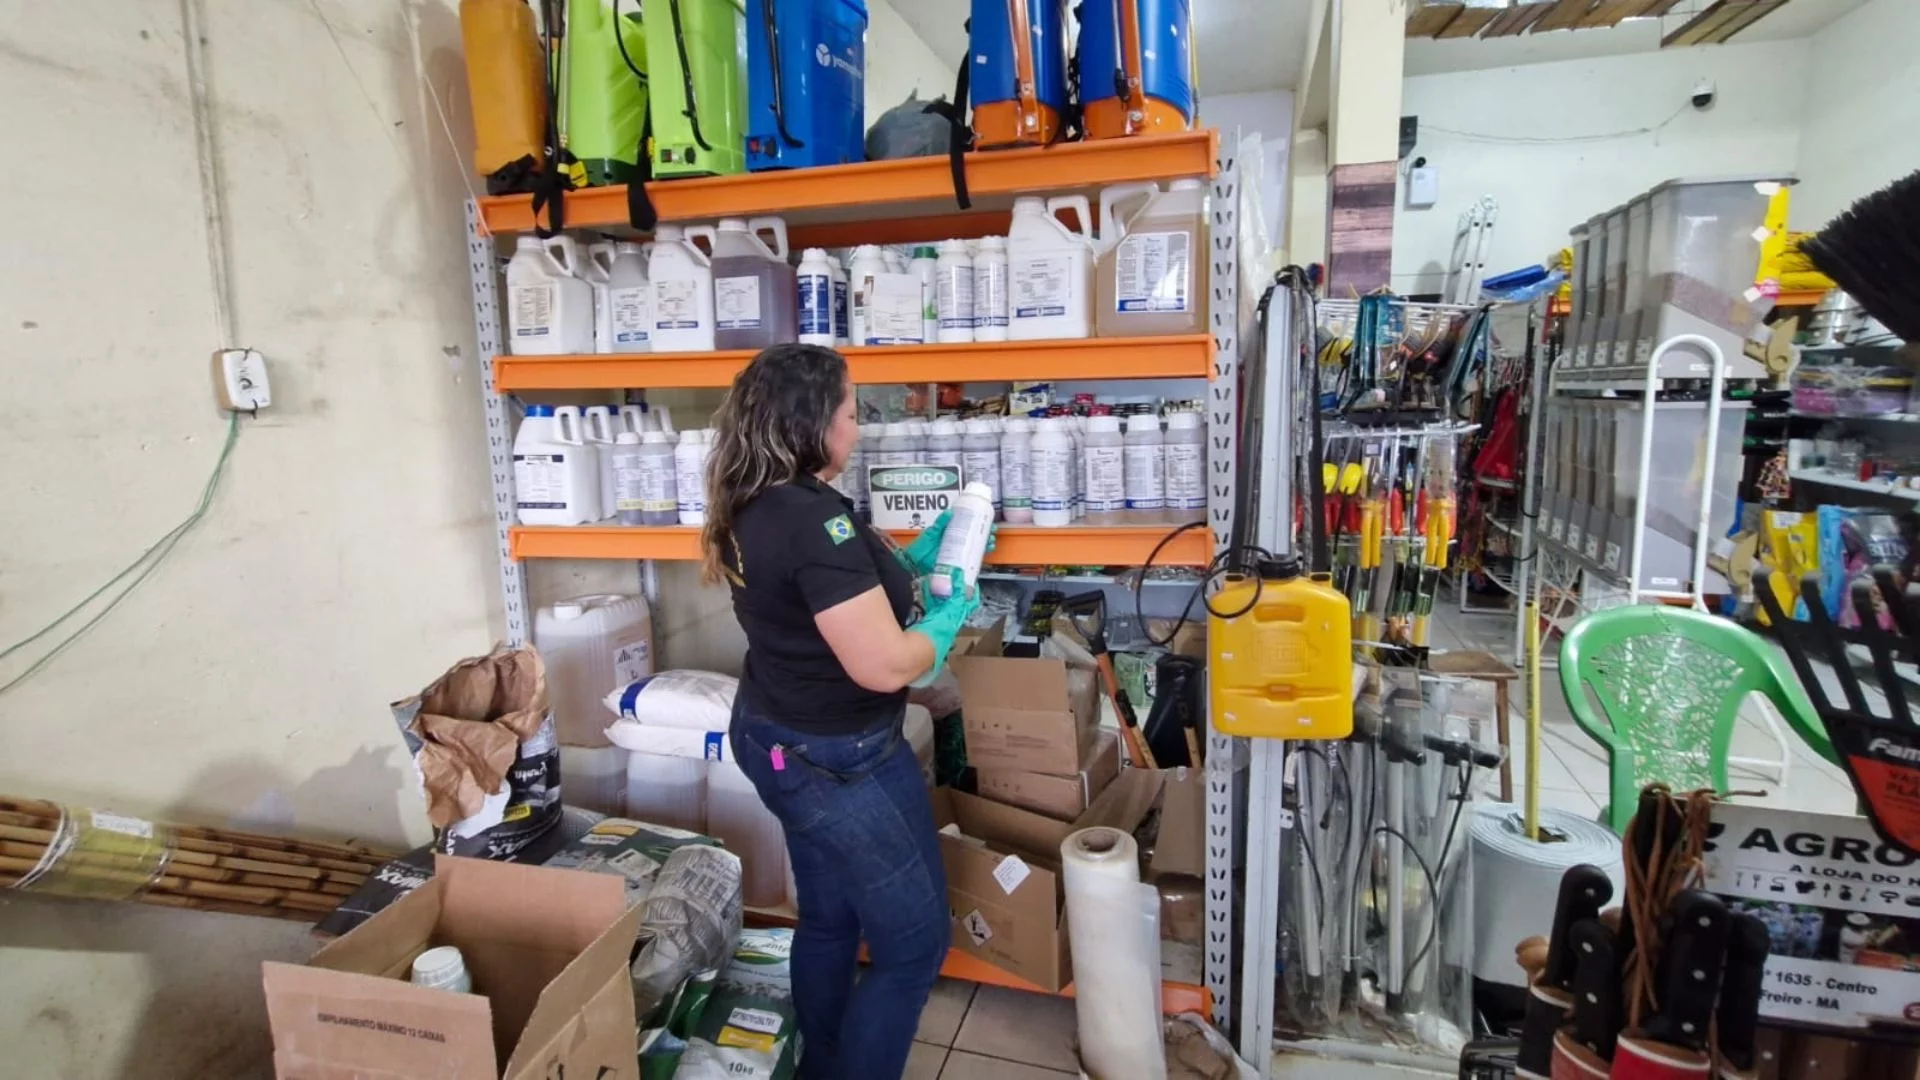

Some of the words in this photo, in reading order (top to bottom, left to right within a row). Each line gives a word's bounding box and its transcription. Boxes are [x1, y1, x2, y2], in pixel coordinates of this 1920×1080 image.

[882, 471, 947, 486] PERIGO
[883, 494, 949, 511] VENENO
[1739, 828, 1916, 867] AGRO
[1789, 864, 1803, 873] A
[1810, 866, 1864, 882] LOJA
[1871, 873, 1901, 884] DO
[1775, 970, 1813, 987] 1635
[1825, 977, 1878, 995] Centro
[1760, 990, 1803, 1005] Freire
[1815, 996, 1840, 1011] MA
